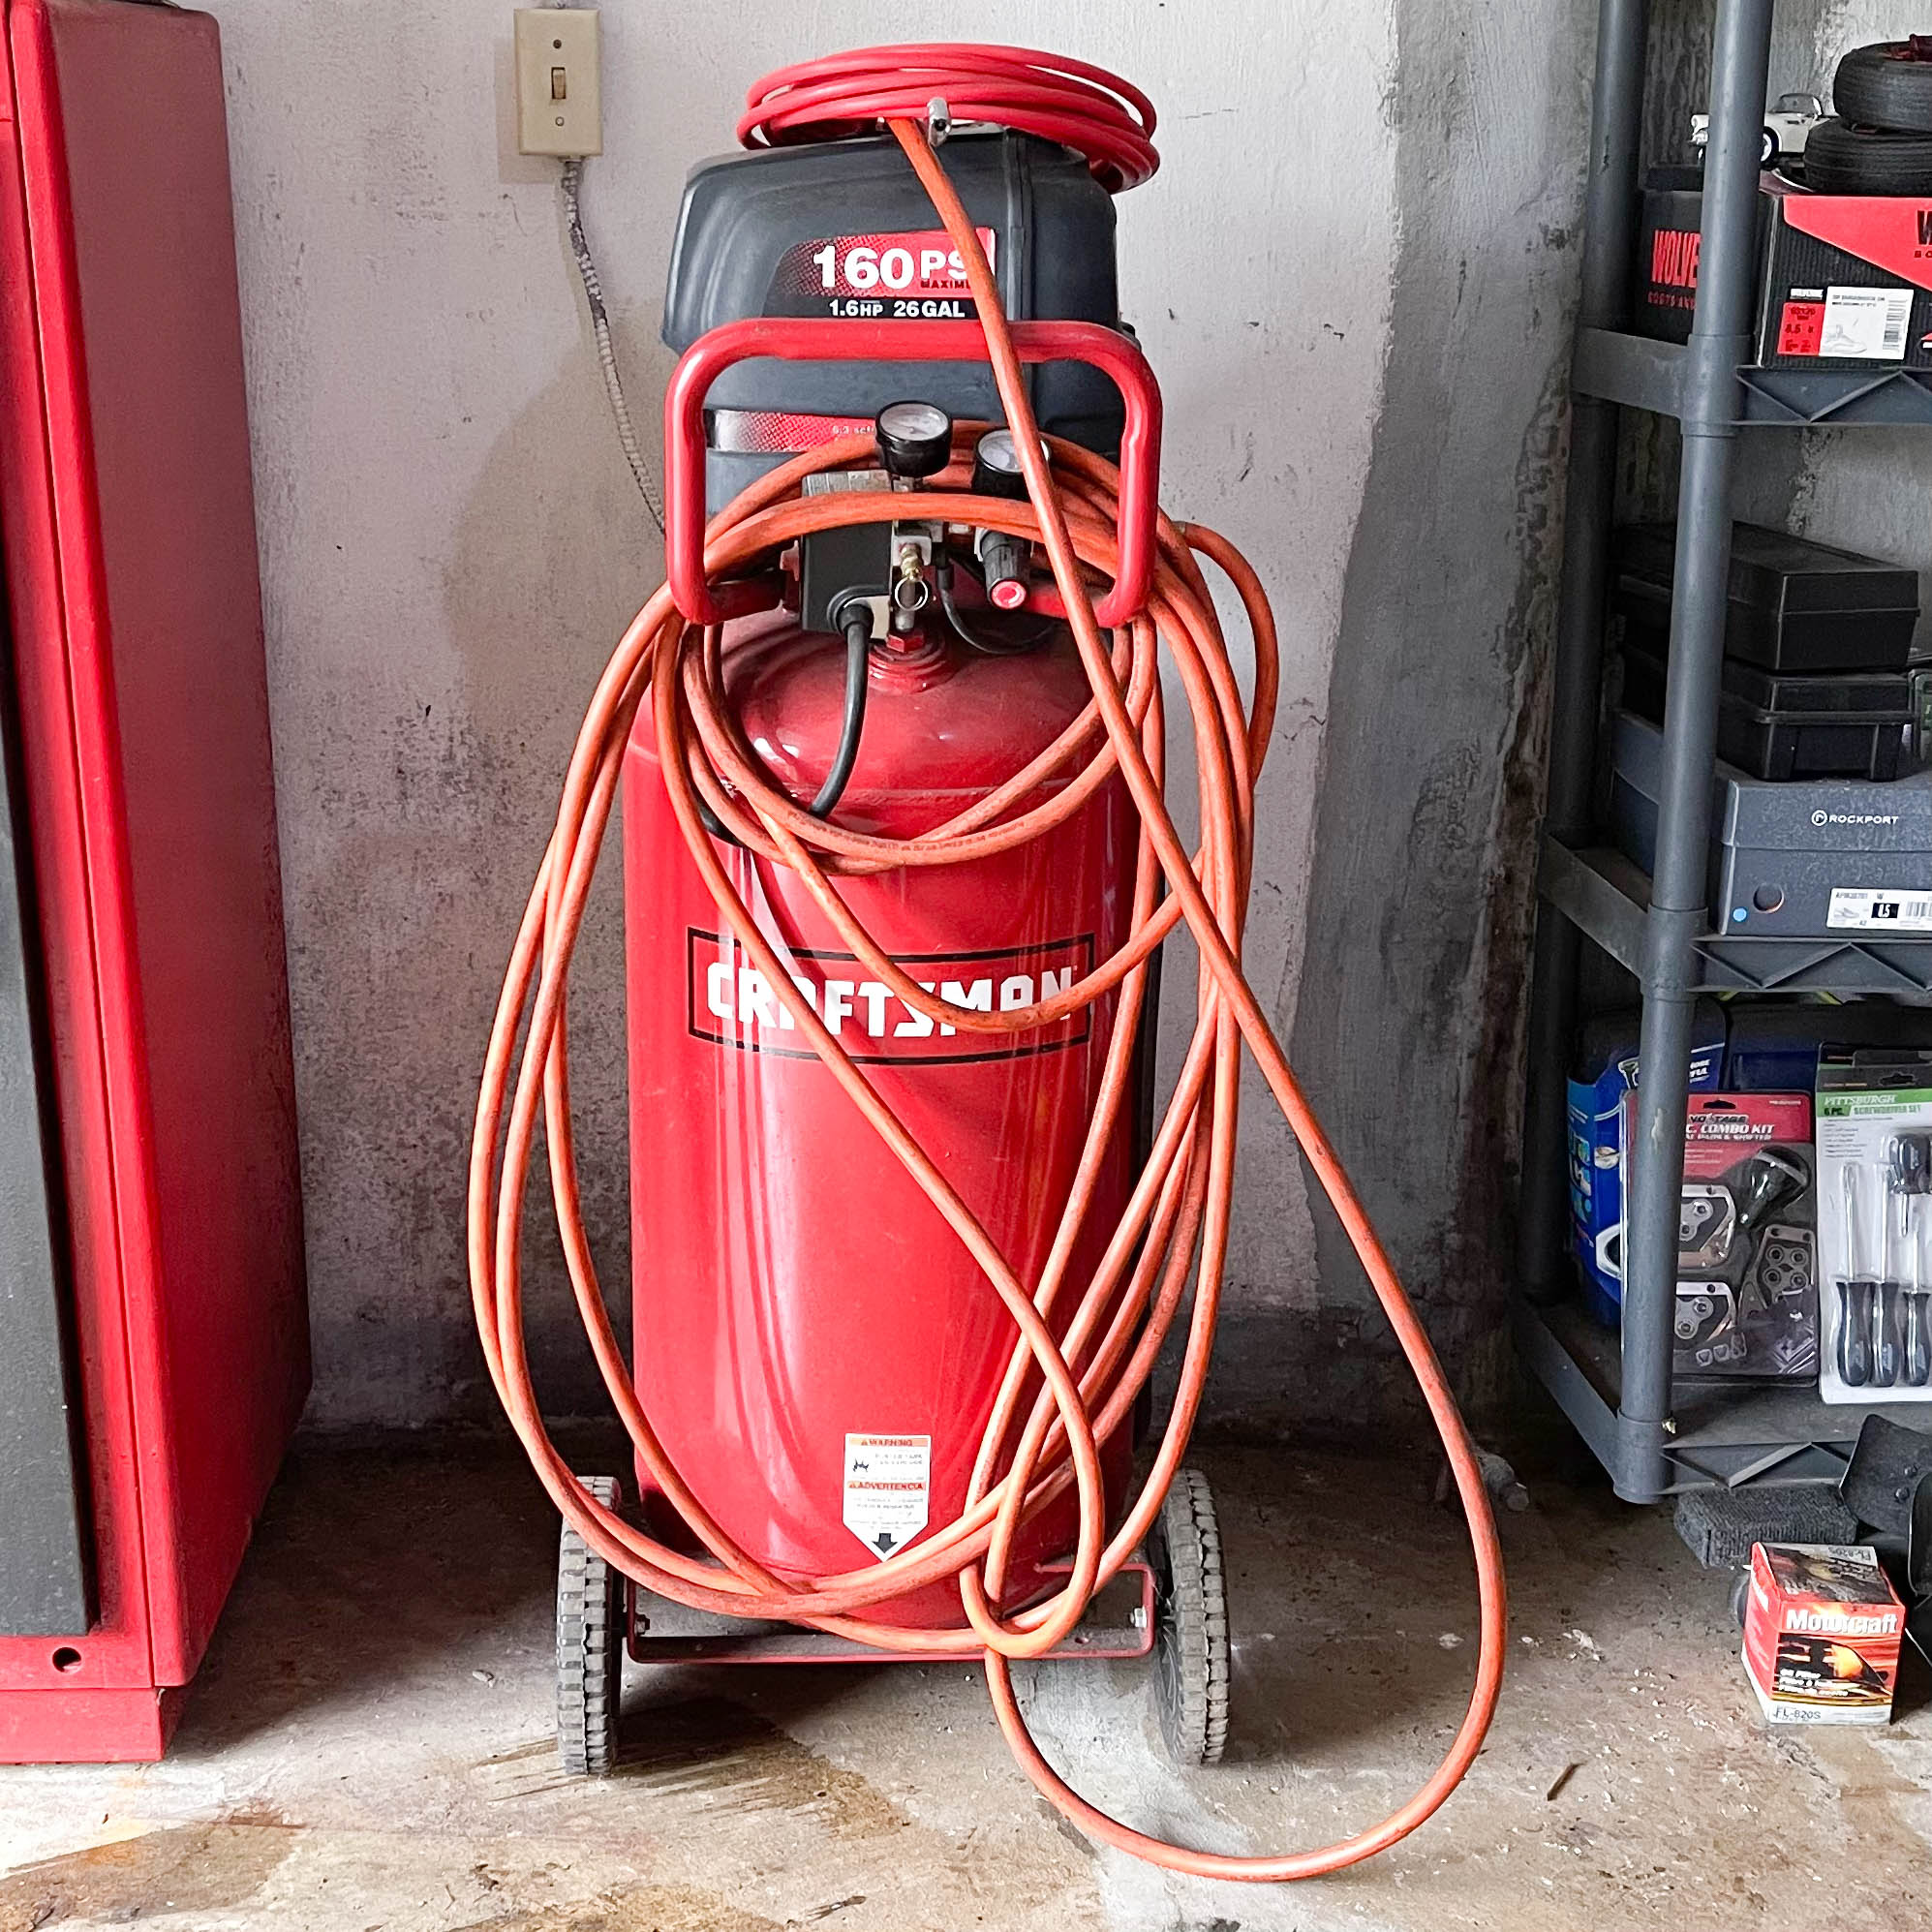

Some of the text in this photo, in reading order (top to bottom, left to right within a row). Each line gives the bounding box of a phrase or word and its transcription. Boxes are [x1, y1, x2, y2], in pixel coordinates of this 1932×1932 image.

[1652, 230, 1702, 288] WOLVE
[813, 245, 968, 290] 160 PS
[921, 280, 971, 290] MAXIM
[1828, 814, 1898, 824] ROCKPORT
[1825, 1094, 1895, 1105] PITTSBURGH
[1701, 1124, 1749, 1134] COMBO
[1751, 1124, 1774, 1134] KIT
[1786, 1609, 1897, 1634] Motorcraft
